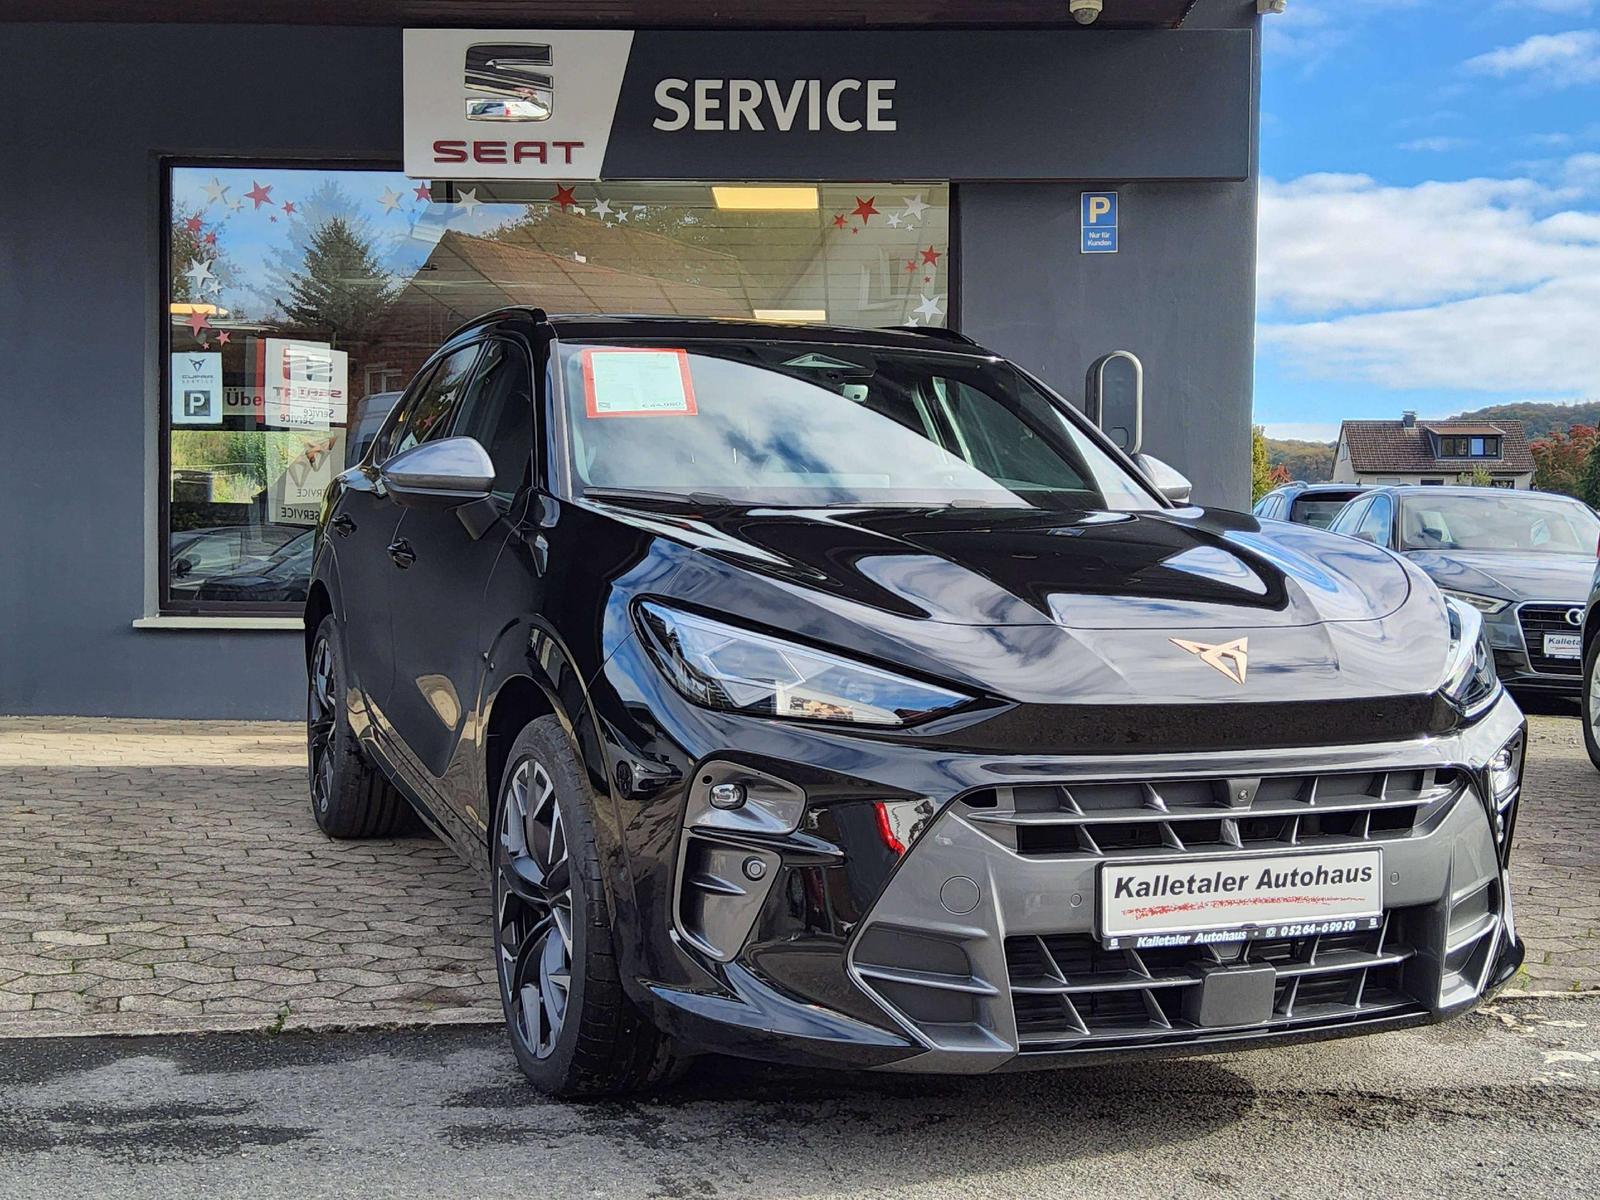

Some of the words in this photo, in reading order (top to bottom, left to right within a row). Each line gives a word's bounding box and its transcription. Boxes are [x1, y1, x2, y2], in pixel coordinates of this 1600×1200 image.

[652, 78, 898, 133] SERVICE
[432, 140, 585, 165] SEAT
[1090, 197, 1110, 223] P
[189, 392, 205, 414] P
[1114, 871, 1249, 898] Kalletaler
[1256, 864, 1373, 890] Autohaus
[1136, 934, 1192, 948] Kalletaler
[1194, 931, 1248, 943] Autohaus
[1280, 920, 1356, 937] 05264-69950
